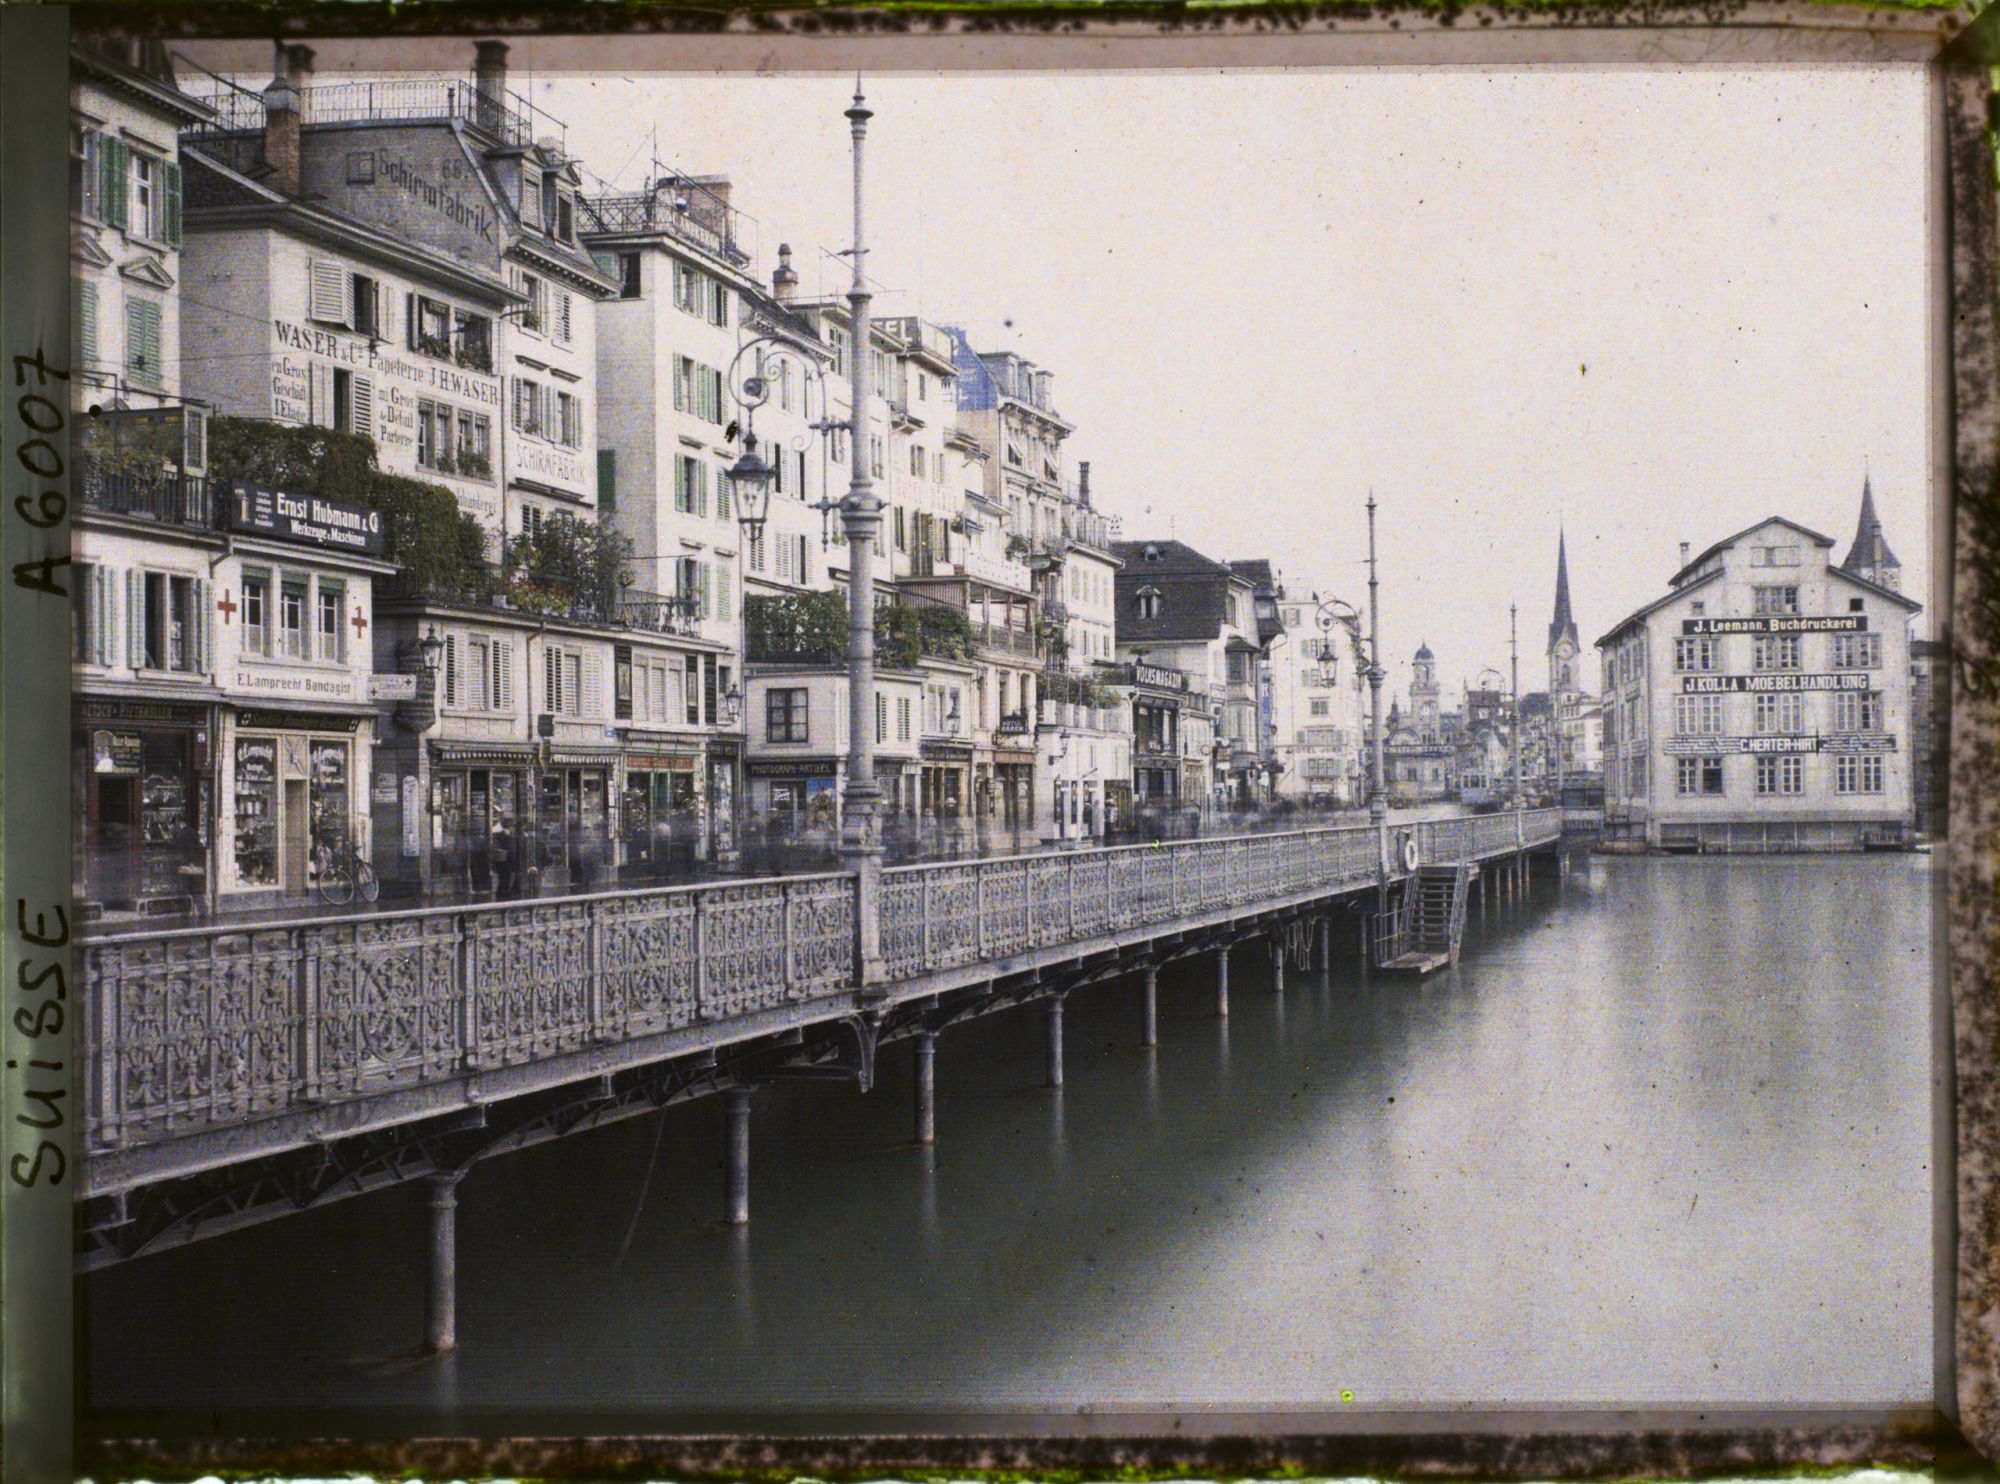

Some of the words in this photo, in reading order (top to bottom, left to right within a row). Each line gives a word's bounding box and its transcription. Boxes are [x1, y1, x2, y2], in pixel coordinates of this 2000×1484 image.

[379, 148, 493, 245] Schirmfabrik
[274, 320, 337, 358] WASER
[283, 357, 306, 378] Gros
[368, 347, 423, 382] Papeterie
[391, 386, 414, 408] Gros
[388, 405, 413, 429] Detail
[13, 348, 69, 529] 6007
[381, 424, 413, 447] Parterre
[516, 443, 586, 486] SCHIRMFABRIK
[276, 492, 308, 518] Ernst
[312, 499, 361, 530] Hubmann
[290, 518, 328, 542] Werkzeuge
[331, 527, 366, 546] Maschinen
[13, 555, 70, 597] A
[1693, 620, 1708, 633] J.
[1769, 617, 1858, 632] Buchdruckerei
[305, 678, 351, 697] Bandagist
